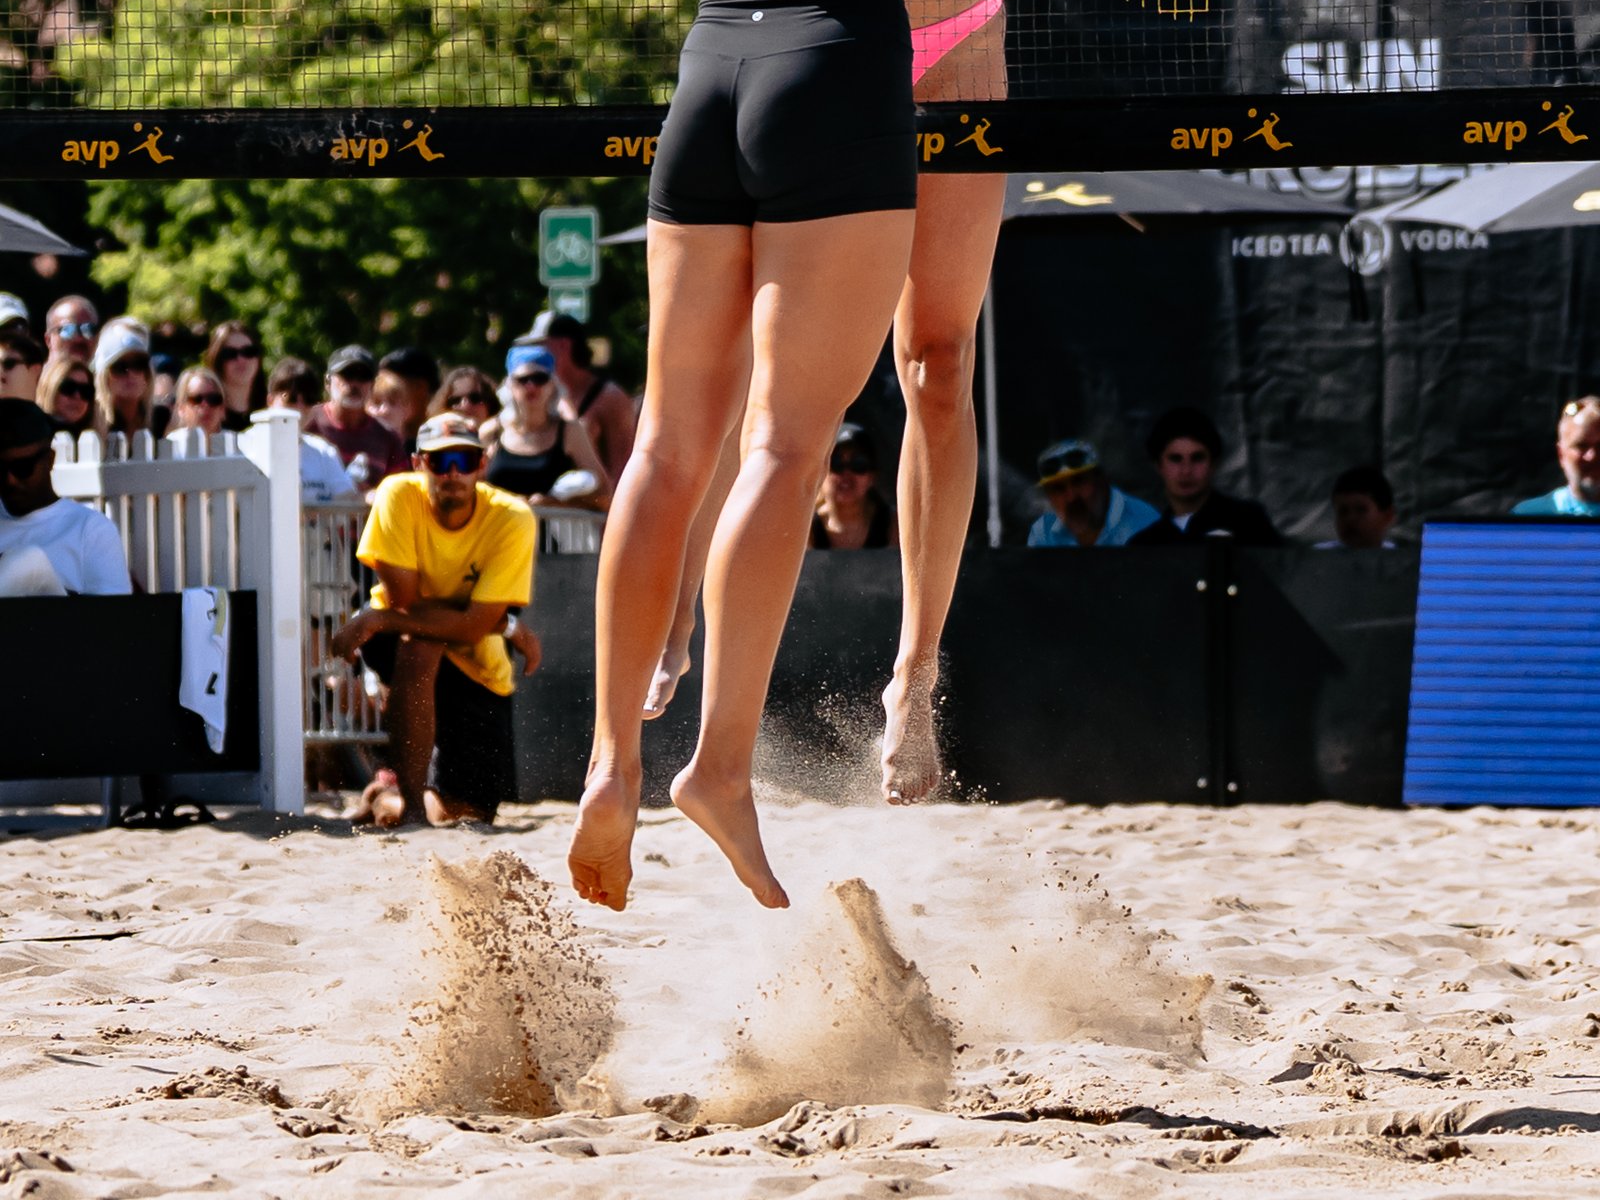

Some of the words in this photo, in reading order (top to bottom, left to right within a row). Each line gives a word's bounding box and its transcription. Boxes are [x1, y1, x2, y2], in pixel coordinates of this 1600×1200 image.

[1171, 127, 1233, 157] avp
[1463, 120, 1527, 151] avp
[61, 139, 120, 169] avp
[330, 137, 389, 167] avp
[1232, 235, 1286, 258] ICED
[1288, 233, 1332, 256] TEA
[1401, 229, 1489, 251] VODKA
